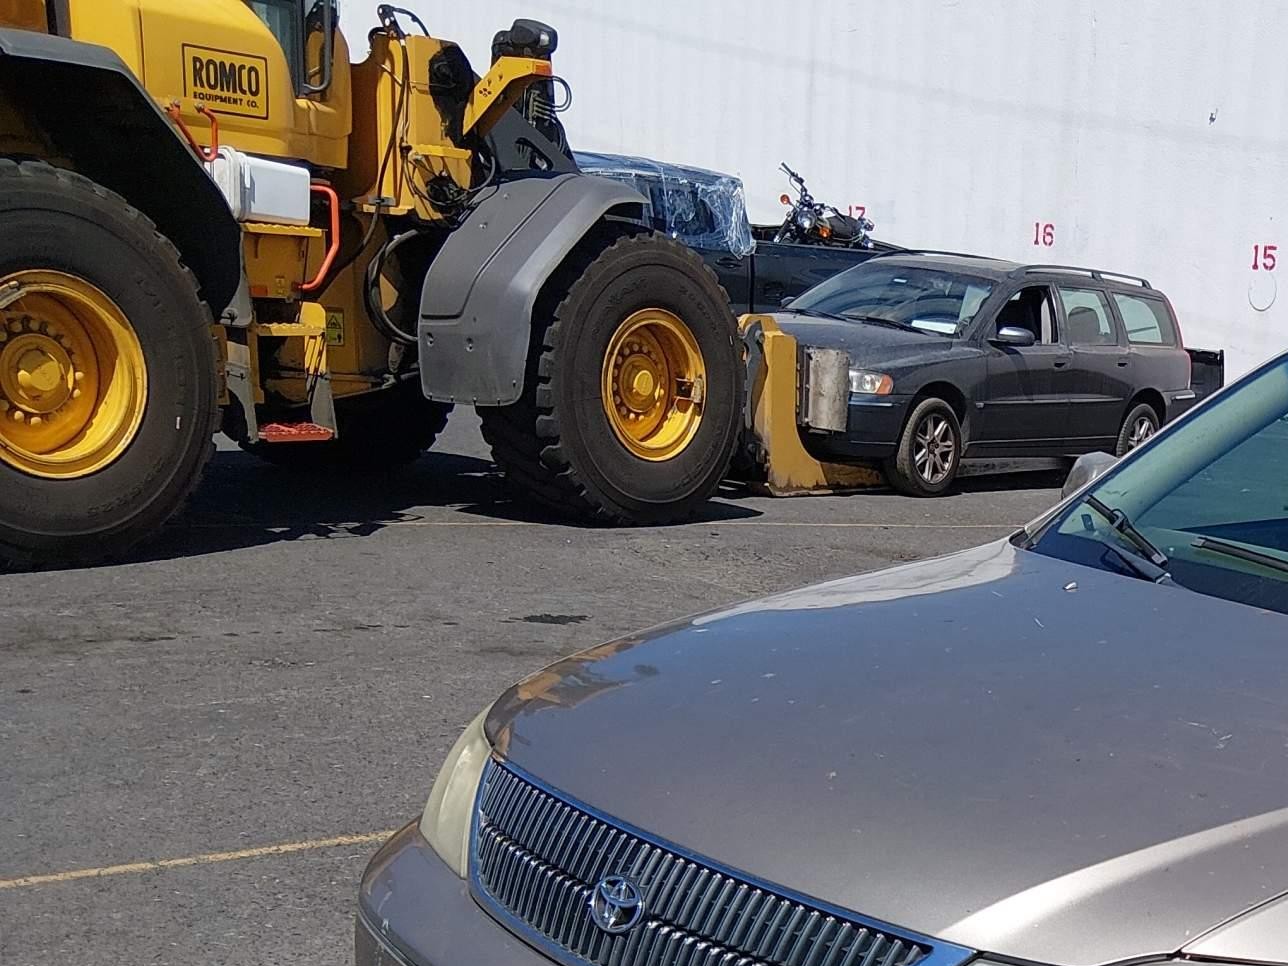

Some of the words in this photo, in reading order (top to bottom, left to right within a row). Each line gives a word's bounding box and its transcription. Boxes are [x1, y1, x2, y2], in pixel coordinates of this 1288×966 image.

[192, 56, 260, 97] ROMCO
[193, 91, 244, 106] EQUIPMENT
[246, 99, 260, 109] CO.
[1034, 222, 1056, 247] 16
[1252, 245, 1278, 271] 15
